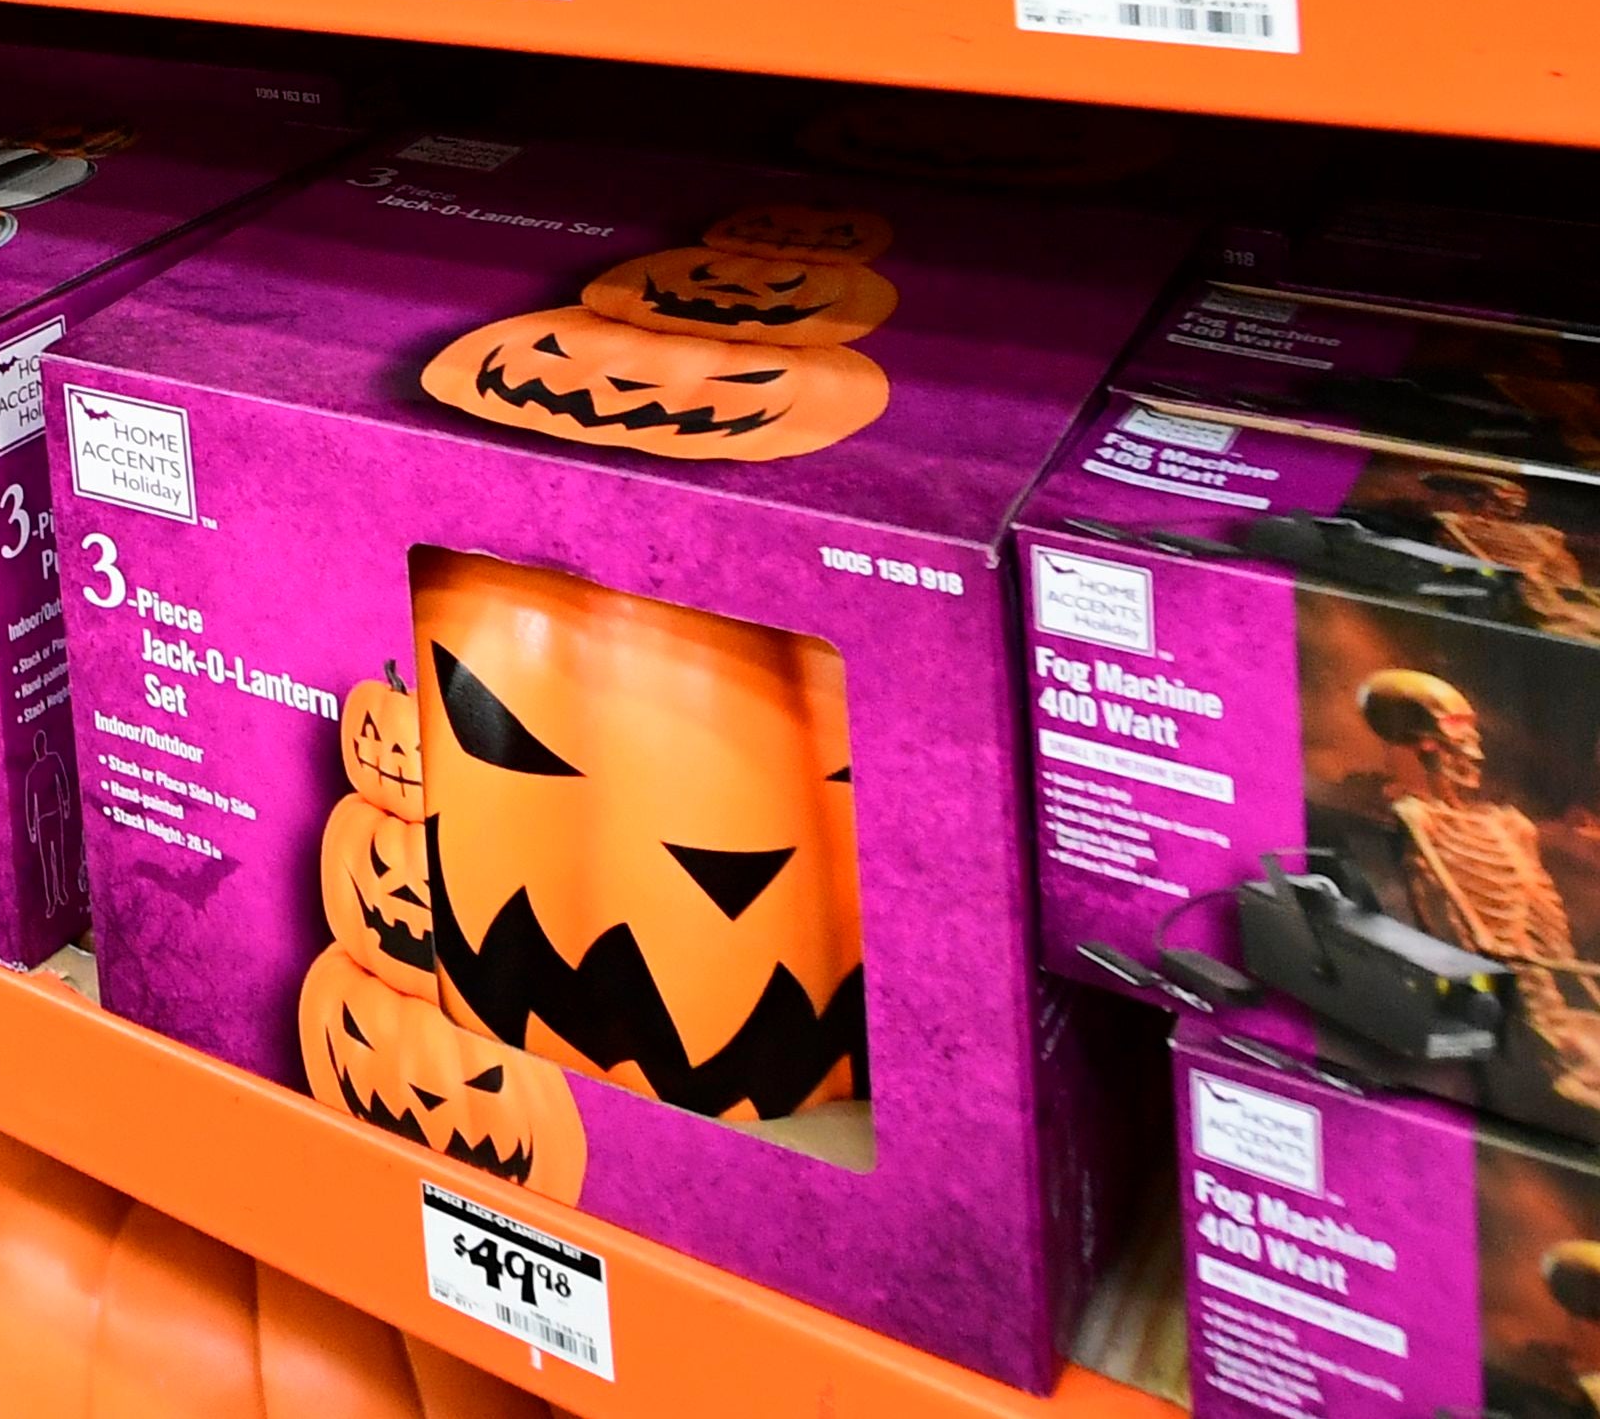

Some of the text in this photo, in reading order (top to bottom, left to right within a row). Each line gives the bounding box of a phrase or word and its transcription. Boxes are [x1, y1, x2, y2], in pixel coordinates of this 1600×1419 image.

[378, 192, 615, 240] Jack-O-Lantern Set
[1235, 319, 1341, 347] Machine
[82, 440, 182, 480] ACCENTS
[113, 421, 179, 455] HOME
[1103, 432, 1280, 481] Fog Machine
[111, 469, 182, 506] Holiday
[1095, 446, 1229, 487] 400 Watt
[820, 546, 965, 596] 1005 158 918
[1078, 579, 1138, 604] HOME
[1048, 590, 1143, 624] ACCENTS
[1074, 614, 1139, 641] Holiday
[141, 629, 341, 722] Jack-O-Lantern
[144, 673, 189, 718] Set
[1035, 645, 1225, 720] Fog Machine
[94, 710, 205, 765] Indoor/Outdoor
[1038, 686, 1180, 750] 400 Watt
[108, 754, 140, 780] Stack
[155, 770, 188, 794] Place
[188, 778, 213, 804] Side
[230, 794, 257, 821] Side
[110, 780, 185, 819] Hand-painted
[112, 807, 145, 832] Stack
[465, 1202, 561, 1250] JACK-O-LANTERN
[1194, 1169, 1398, 1273] Fog Machine
[1197, 1212, 1350, 1296] 400 Watt
